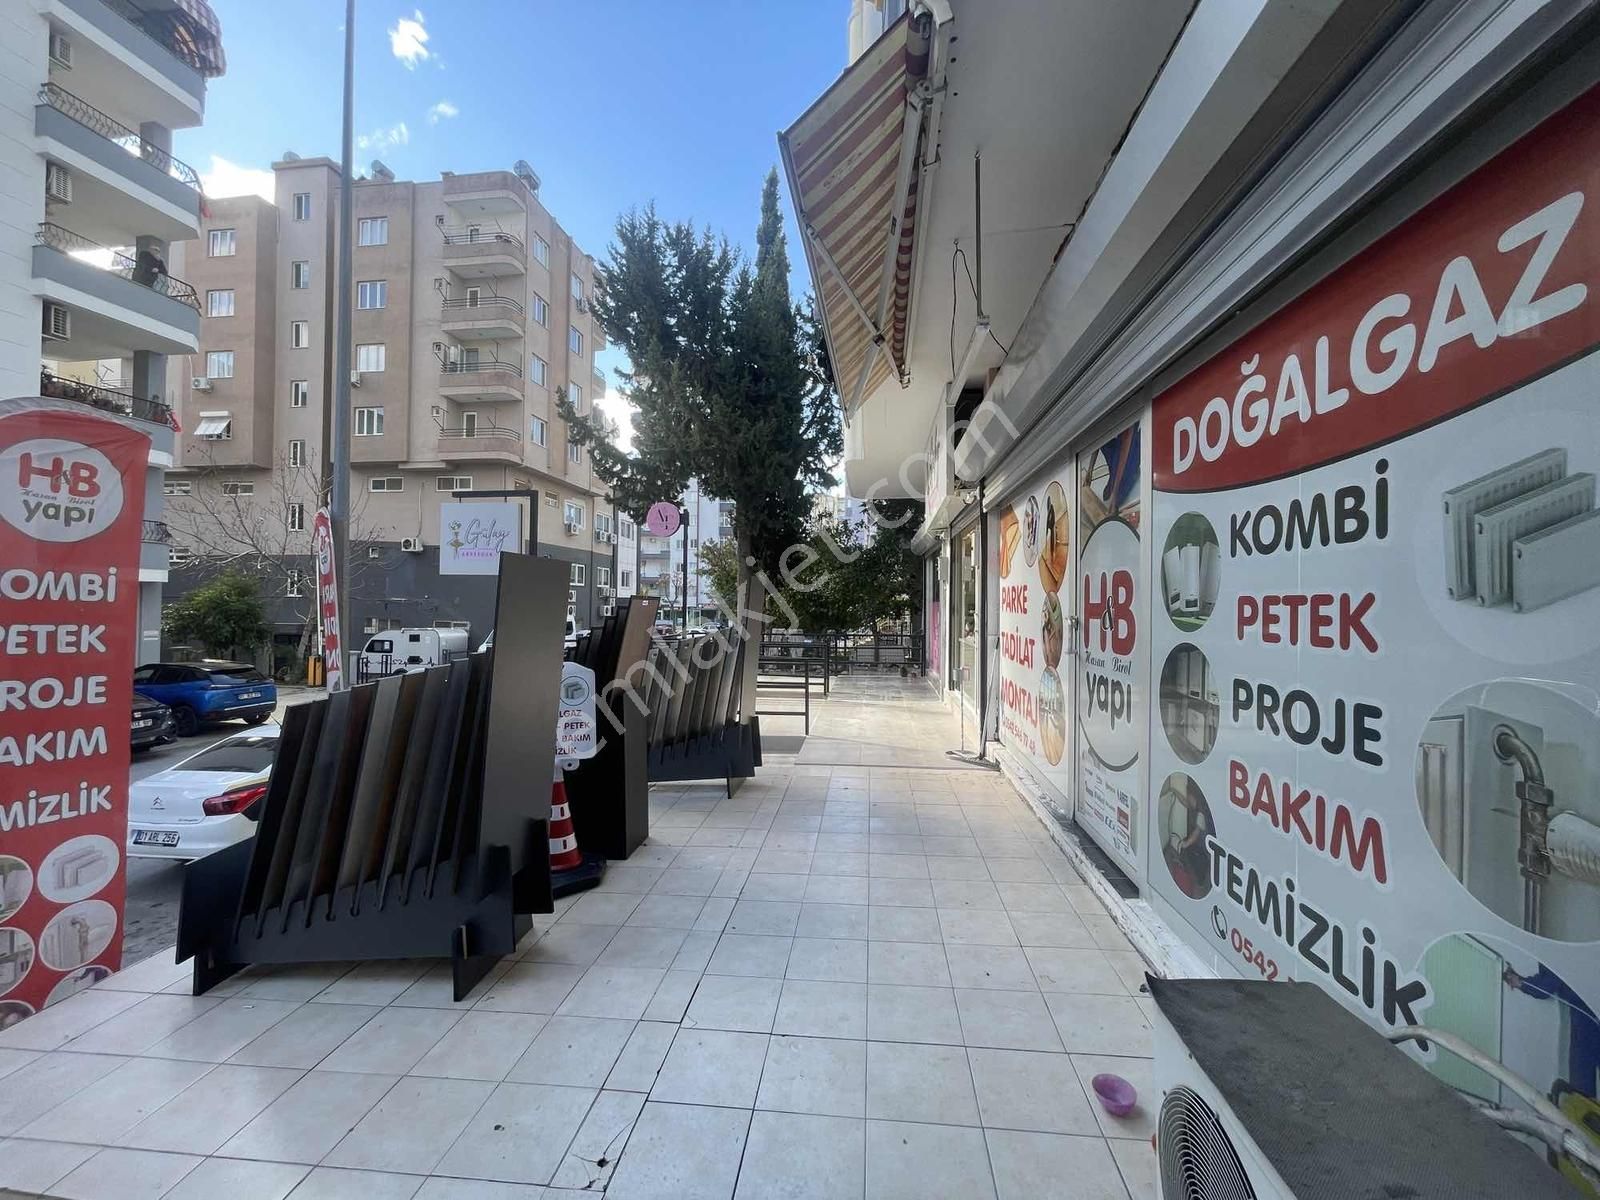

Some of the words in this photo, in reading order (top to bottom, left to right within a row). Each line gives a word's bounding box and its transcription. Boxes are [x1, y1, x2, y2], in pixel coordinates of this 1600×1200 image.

[1173, 191, 1587, 474] DOĞALGAZ
[19, 452, 101, 498] H&B
[23, 499, 95, 528] yapı
[1230, 458, 1389, 558] KOMBİ
[0, 566, 118, 602] OMBİ
[1001, 584, 1028, 615] PARKE
[1083, 570, 1136, 656] H&B
[1236, 592, 1379, 653] PETEK
[1001, 625, 1036, 670] TADİLAT
[1112, 656, 1132, 676] Birol
[0, 675, 108, 711] ROJE
[559, 709, 582, 718] LGAZ
[1001, 675, 1038, 728] MONTAJ
[1086, 671, 1132, 730] yapı
[0, 726, 108, 766] AKIM
[562, 733, 591, 742] BAKIM
[564, 721, 590, 730] PETEK
[1232, 678, 1383, 767] PROJE
[0, 781, 112, 832] MİZLİK
[1229, 759, 1387, 884] BAKIM
[1208, 840, 1429, 1052] TEMİZLİK
[1231, 927, 1278, 984] 0542
